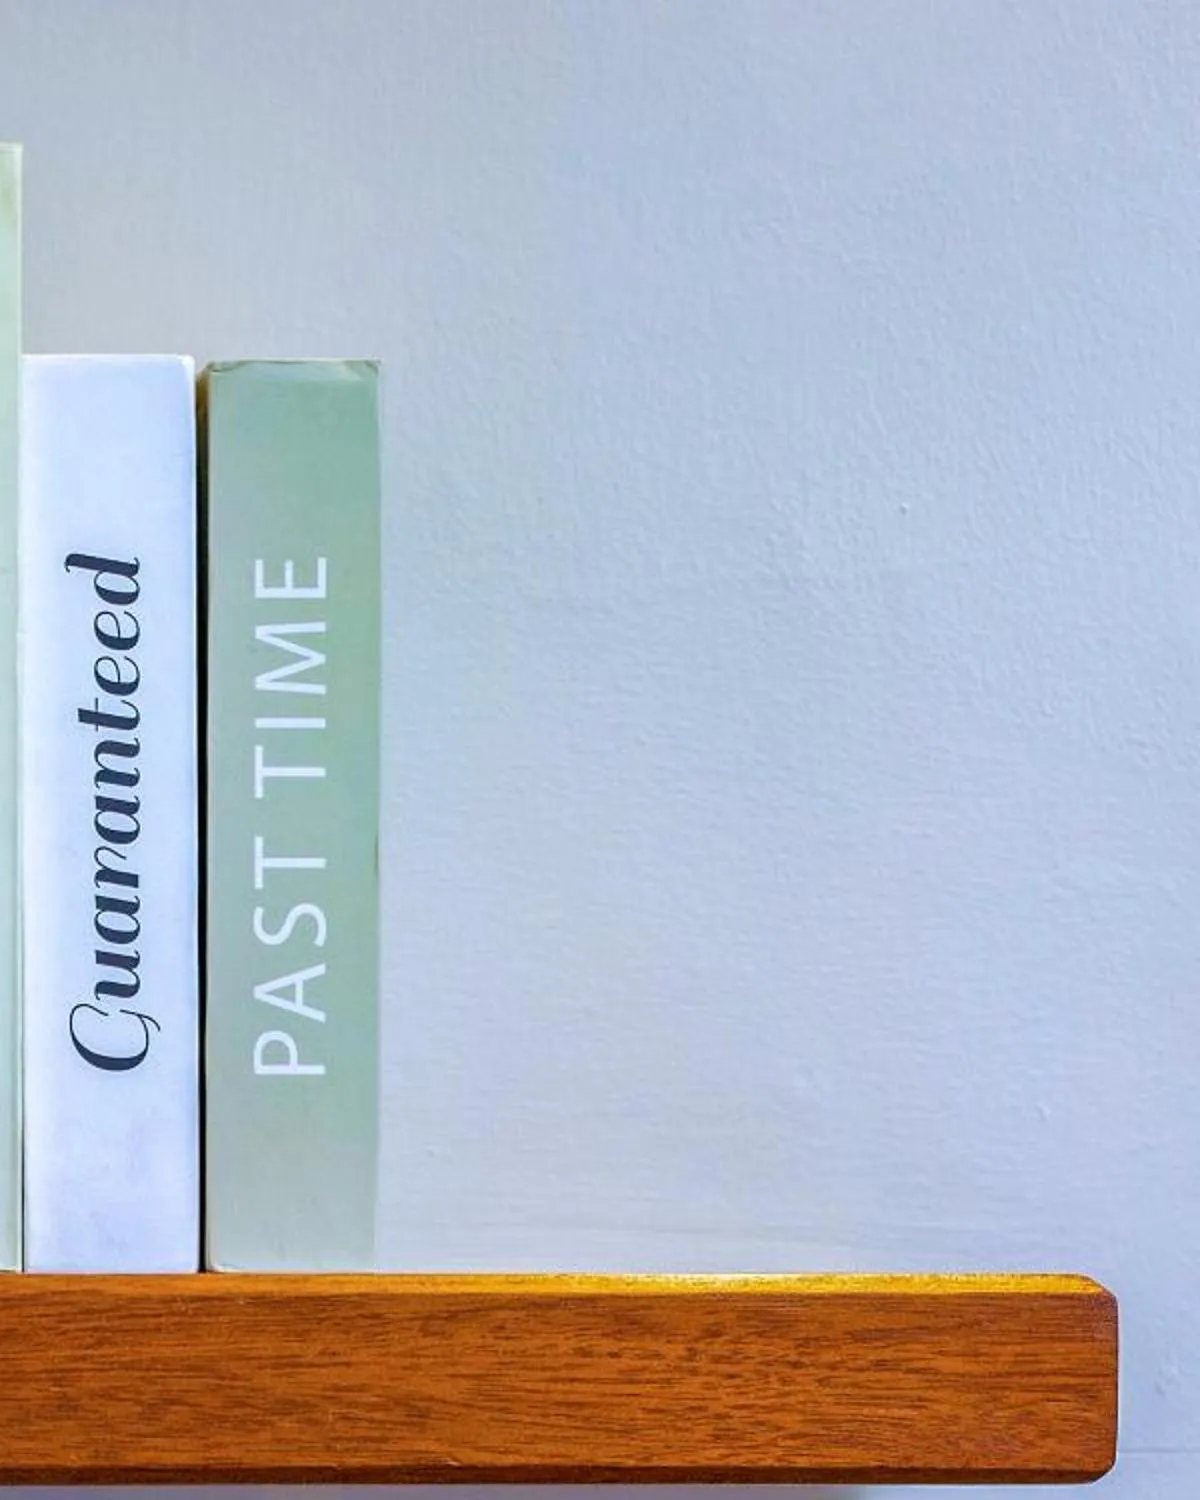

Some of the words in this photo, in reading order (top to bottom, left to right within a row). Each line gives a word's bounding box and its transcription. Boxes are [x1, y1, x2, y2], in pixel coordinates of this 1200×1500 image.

[253, 556, 327, 799] TIME
[64, 553, 161, 1072] Guaranteed
[253, 836, 327, 1075] PAST
